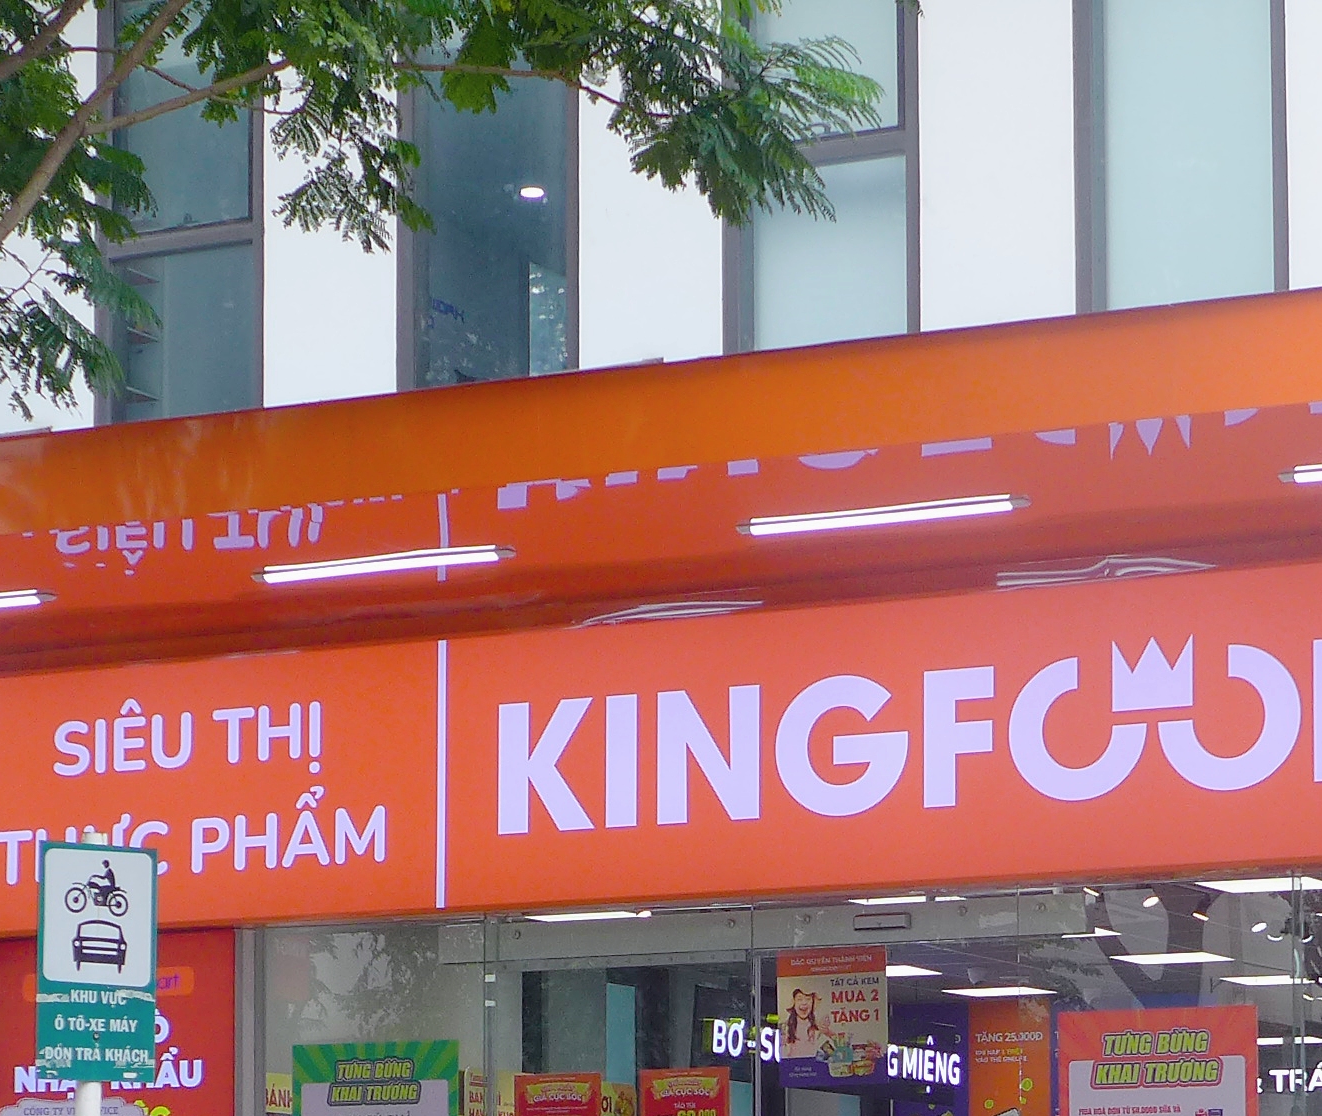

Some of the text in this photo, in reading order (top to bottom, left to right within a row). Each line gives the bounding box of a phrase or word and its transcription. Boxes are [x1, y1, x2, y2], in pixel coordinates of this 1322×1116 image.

[52, 698, 322, 777] SIÊU THỊ
[190, 785, 387, 874] PHẨM
[70, 988, 98, 1004] KHU
[831, 988, 879, 1004] MUA 2
[54, 1013, 65, 1031] Ô
[109, 1015, 138, 1033] MÁY
[830, 1006, 880, 1026] TẶNG 1
[75, 1043, 102, 1061] TRẢ
[105, 1046, 149, 1063] KHÁCH
[902, 1034, 961, 1094] MIỆNG
[1095, 1063, 1141, 1086] KHAI
[330, 1085, 364, 1103] KHAI
